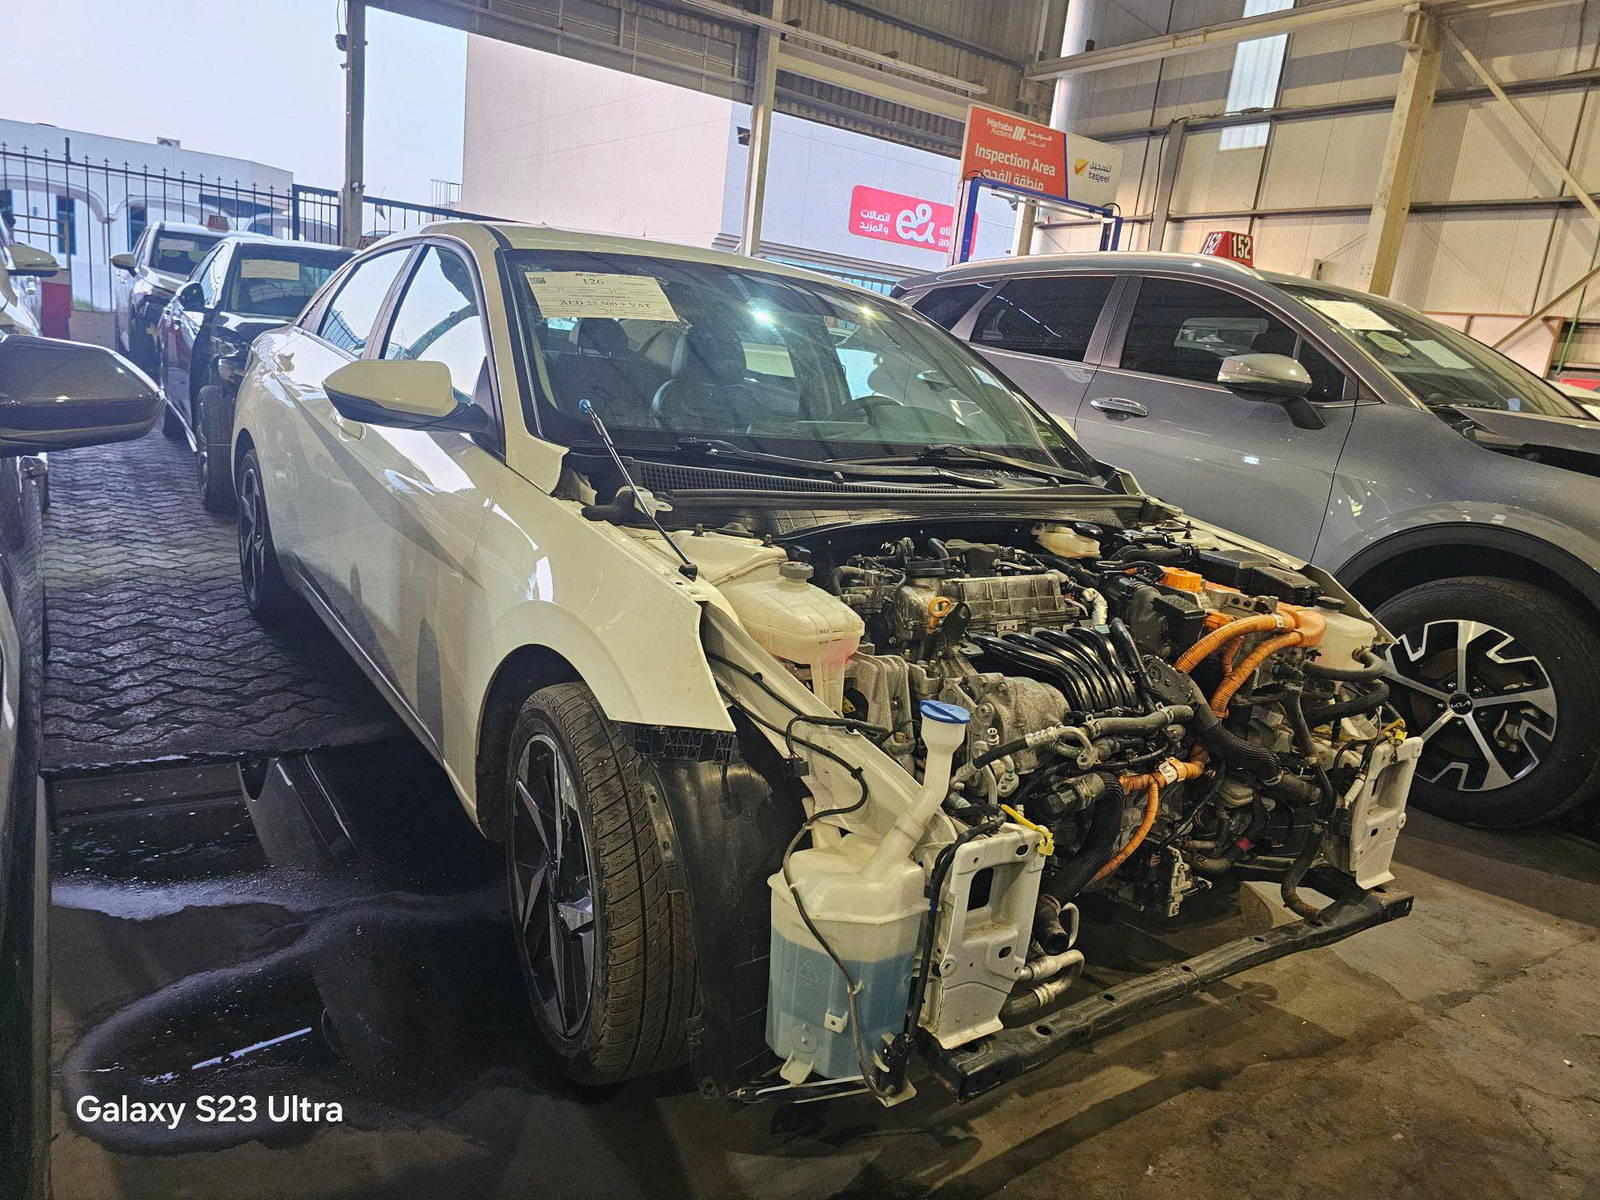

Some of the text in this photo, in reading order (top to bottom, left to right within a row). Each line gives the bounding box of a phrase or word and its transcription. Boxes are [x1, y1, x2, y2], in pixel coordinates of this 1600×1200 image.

[975, 142, 1030, 169] Inspection
[1031, 157, 1056, 177] Area
[1090, 161, 1113, 173] تسجيل
[1013, 172, 1044, 191] منطقة
[1088, 171, 1111, 184] tasjeel
[860, 208, 891, 223] اتصالات
[858, 220, 889, 235] والمزيد
[1232, 234, 1251, 259] 152
